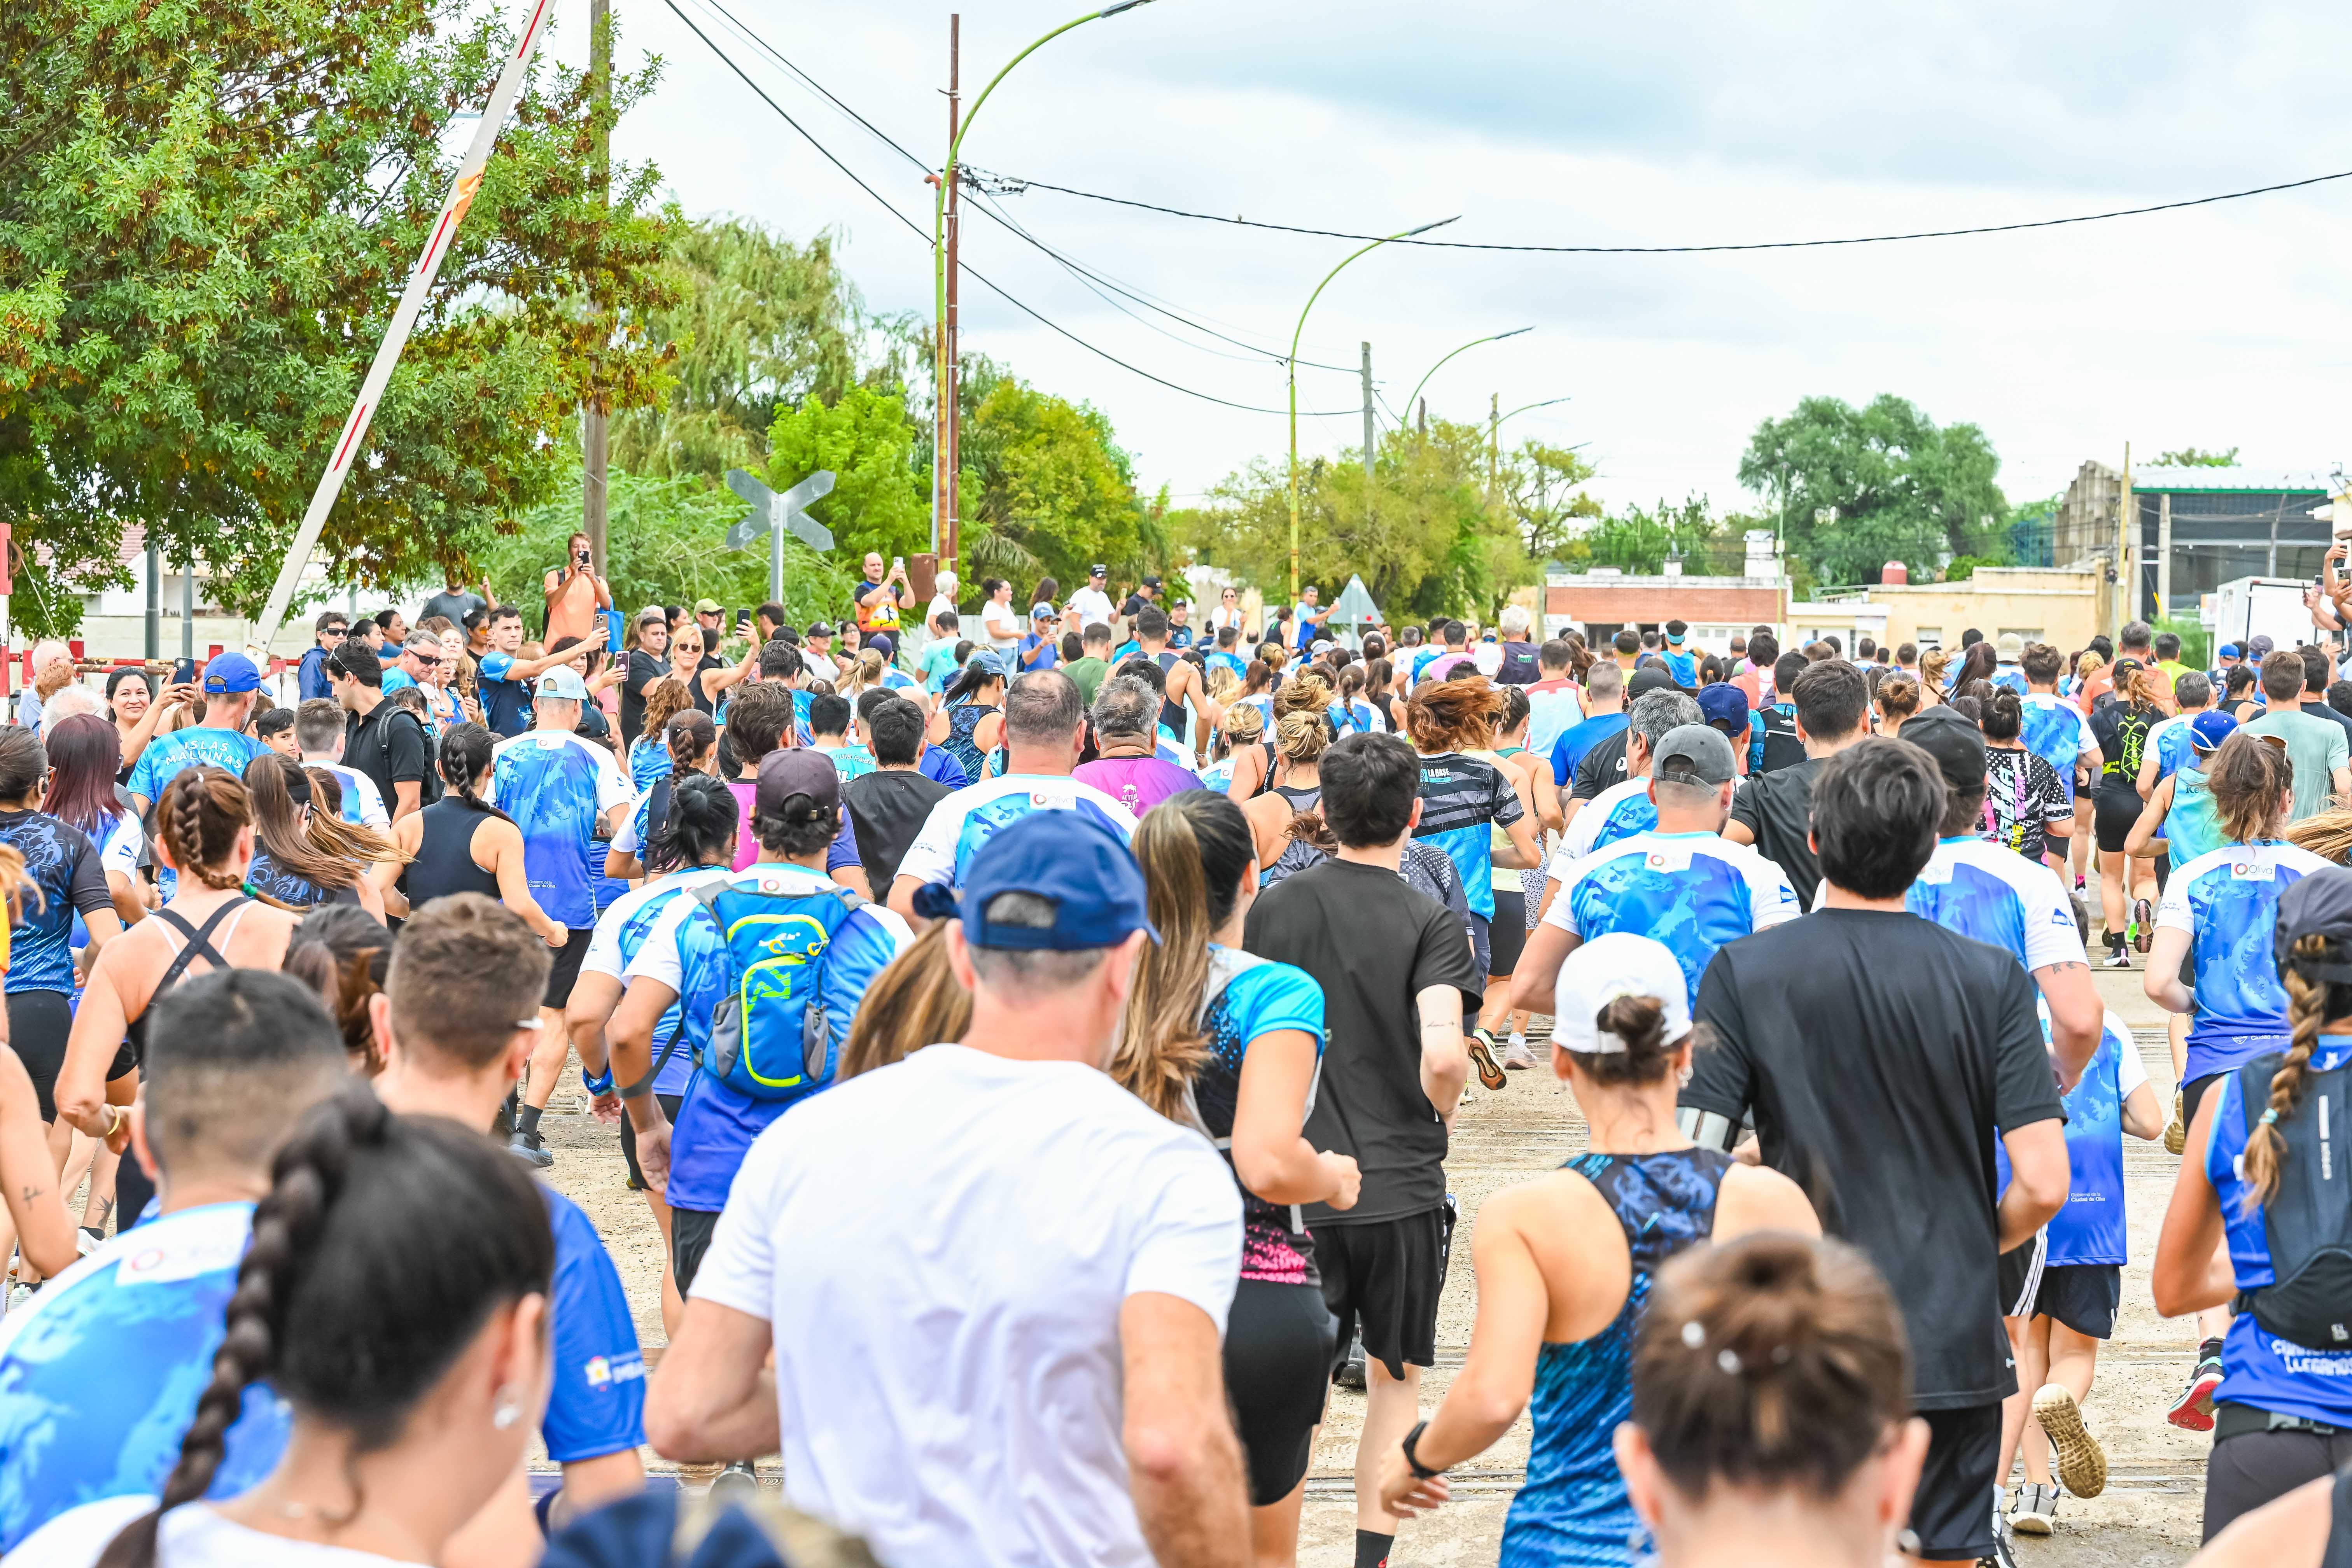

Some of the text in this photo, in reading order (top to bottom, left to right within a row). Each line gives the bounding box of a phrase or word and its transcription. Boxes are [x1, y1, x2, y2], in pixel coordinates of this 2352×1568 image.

[184, 740, 230, 752] ISLAS
[166, 750, 243, 769] MALVINAS
[1428, 768, 1450, 777] LA BASE
[1048, 795, 1073, 805] Oliva
[2249, 864, 2273, 875] Oliva
